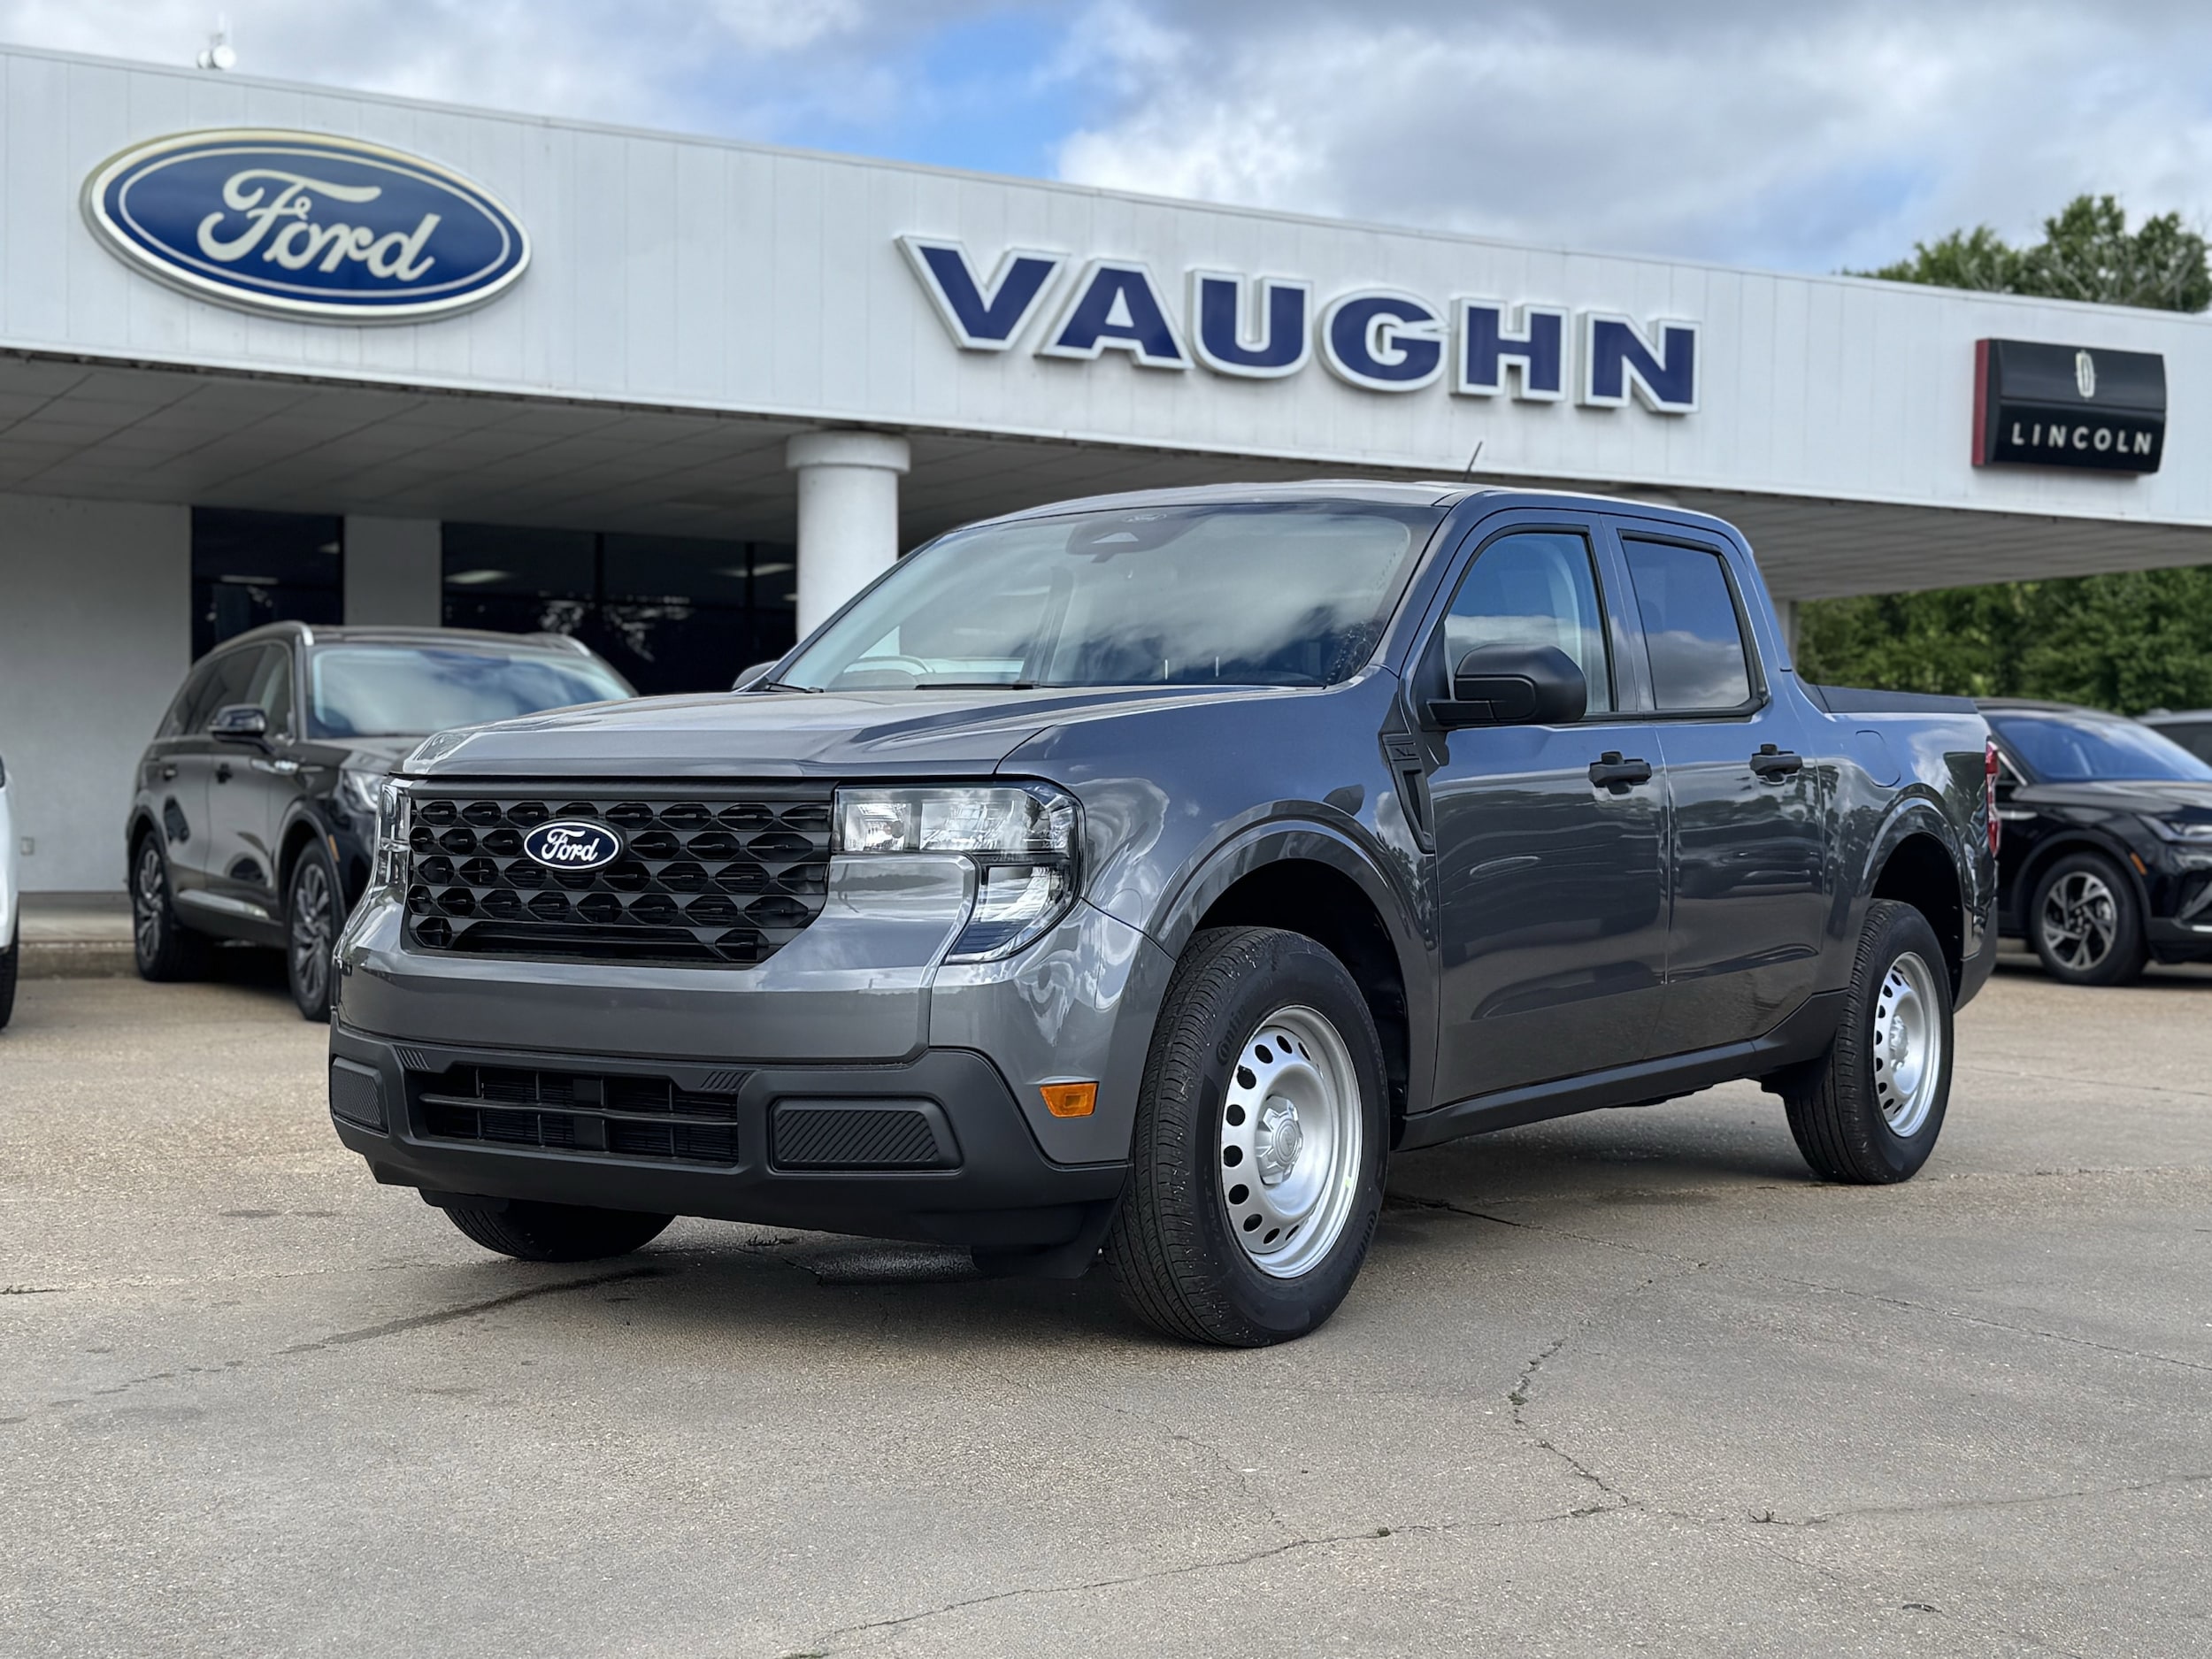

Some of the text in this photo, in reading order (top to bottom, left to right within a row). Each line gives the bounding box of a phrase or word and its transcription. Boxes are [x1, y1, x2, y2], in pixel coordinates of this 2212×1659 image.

[196, 168, 442, 281] Ford
[897, 235, 1701, 414] VAUGHN
[2010, 421, 2153, 455] LINCOLN
[541, 828, 601, 862] Ford
